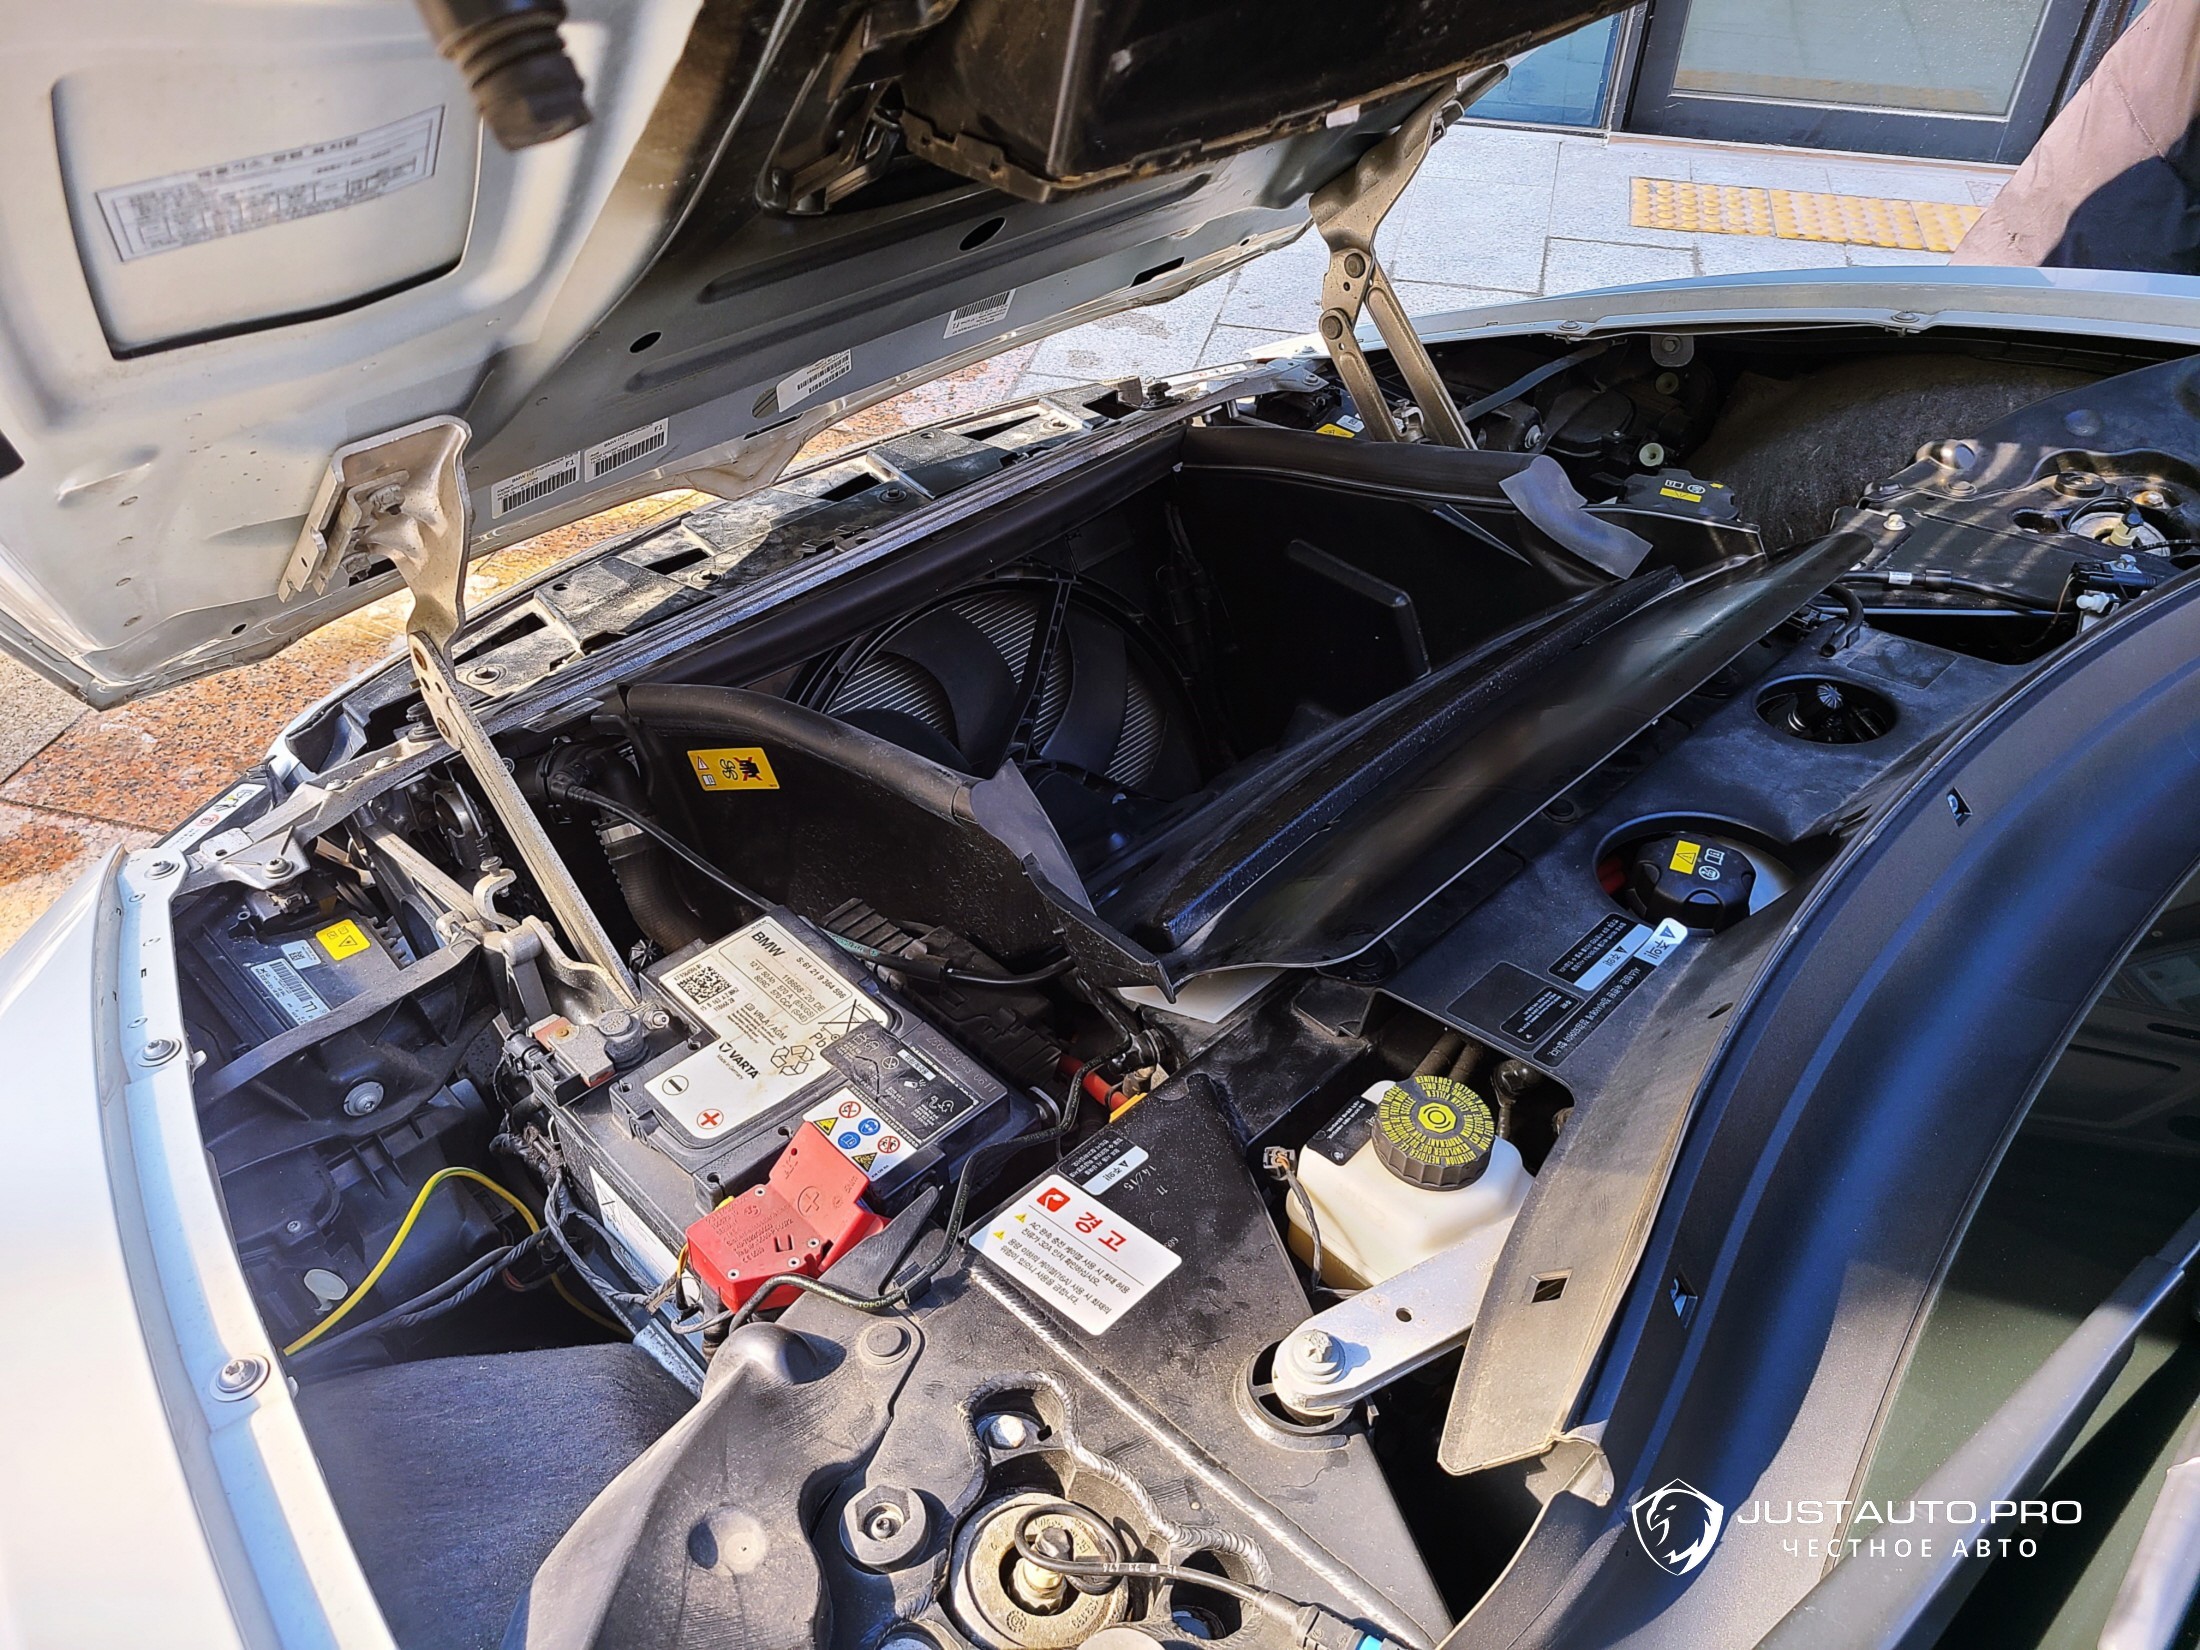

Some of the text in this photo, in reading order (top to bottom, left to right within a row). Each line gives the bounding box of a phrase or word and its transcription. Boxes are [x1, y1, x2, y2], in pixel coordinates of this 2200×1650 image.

[652, 423, 664, 432] F1
[563, 458, 575, 467] F1
[751, 930, 785, 956] BMW
[1602, 950, 1620, 966] 주의!
[1643, 939, 1669, 964] 주의!
[809, 968, 819, 976] 21
[821, 978, 835, 989] 364
[832, 987, 846, 998] 596
[812, 1001, 825, 1011] DE
[753, 1009, 769, 1025] VRLA
[770, 1026, 787, 1040] AGM
[808, 1031, 826, 1047] Pb
[729, 1049, 758, 1078] VARTA
[1415, 1075, 1452, 1086] CONTAINER
[1420, 1082, 1436, 1091] ONLY
[1436, 1083, 1450, 1093] USE
[1425, 1090, 1448, 1099] FILLER
[1454, 1082, 1476, 1099] SEALED
[1451, 1097, 1464, 1110] CLEAN
[1479, 1103, 1490, 1117] FROM
[1399, 1142, 1410, 1150] CE
[1419, 1144, 1432, 1154] QUE
[1409, 1148, 1440, 1164] NETTOYER
[1445, 1150, 1474, 1165] ATTENTION
[1102, 1167, 1122, 1181] 주의!
[1021, 1227, 1099, 1286] 전류가 32A 인지 확인하십시오.
[1028, 1221, 1041, 1230] AC
[1050, 1237, 1066, 1248] 충전
[1063, 1245, 1084, 1261] 케이블
[1081, 1258, 1096, 1269] 사용
[1094, 1267, 1104, 1275] 시
[1102, 1272, 1117, 1284] 최대
[1115, 1281, 1130, 1293] 허용
[1000, 1245, 1078, 1305] 위험이 있으니 사용을 금합니다.
[1007, 1238, 1112, 1314] 용량 이하의 케이블(16A) 사용 시 화재의
